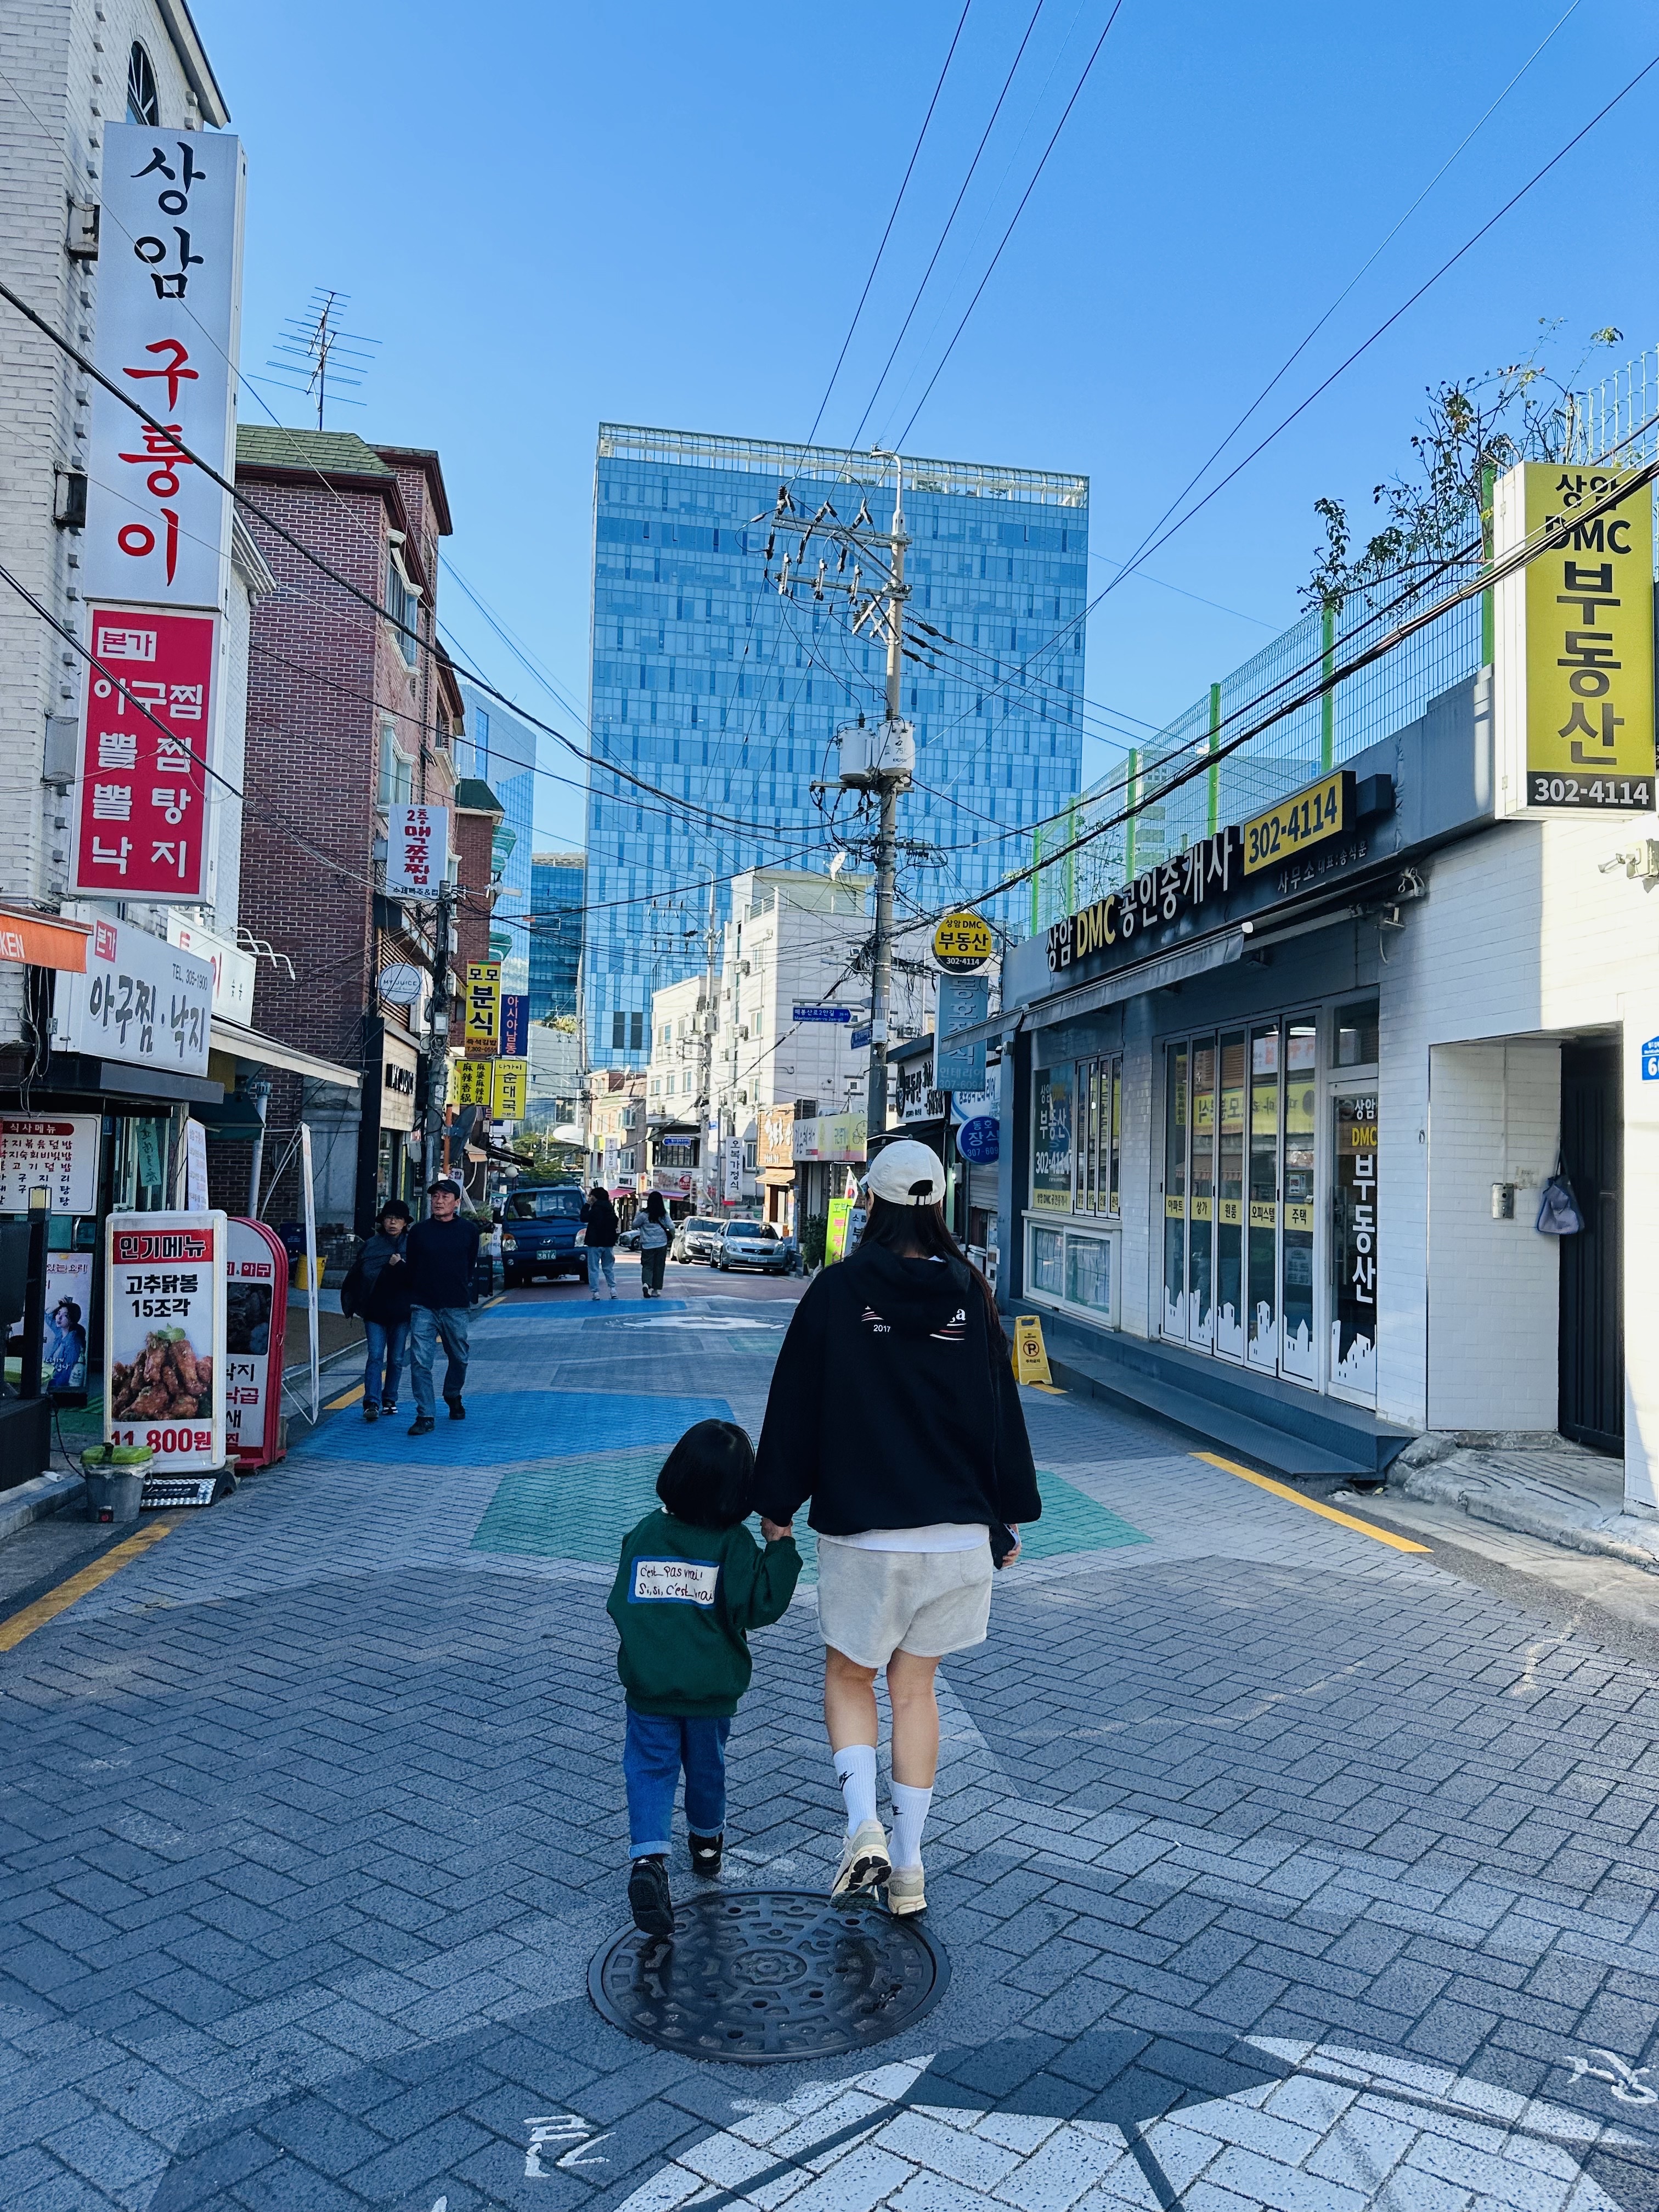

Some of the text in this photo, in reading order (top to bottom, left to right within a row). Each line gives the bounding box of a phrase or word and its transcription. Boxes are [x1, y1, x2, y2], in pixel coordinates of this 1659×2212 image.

[131, 142, 205, 300] 상암
[1555, 473, 1620, 511] 상암
[1544, 515, 1632, 555] DMC
[102, 632, 152, 656] 본가
[1556, 561, 1625, 766] 부동산
[94, 678, 204, 720] 아구찜
[1534, 778, 1649, 805] 302-4114
[407, 809, 429, 825] 2층
[1249, 785, 1338, 865] 302-4114
[1278, 860, 1315, 894] 사무소
[1046, 834, 1233, 973] 상암 DMC 공인중개사
[946, 919, 982, 929] 상암 DMC
[97, 926, 116, 958] 본가
[939, 932, 989, 952] 부동산
[946, 957, 980, 966] 302-4114
[186, 968, 208, 991] 305-1900
[468, 968, 500, 981] 모모
[469, 985, 496, 1036] 분식
[949, 979, 979, 1066] 동호식
[939, 1066, 985, 1079] 인테리어
[905, 1070, 922, 1105] 부동산
[939, 1080, 984, 1091] 307-6094
[1354, 1098, 1376, 1120] 상암
[10, 1123, 56, 1134] 식사메뉴
[973, 1120, 992, 1130] 동호
[1351, 1126, 1378, 1147] DMC
[730, 1140, 740, 1190] 오복가정식
[1168, 1200, 1183, 1214] 아파트
[1197, 1200, 1207, 1215] 상가
[1225, 1203, 1237, 1219] 원룸
[1251, 1206, 1275, 1223] 오피스텔
[1292, 1208, 1307, 1225] 주택
[1352, 1154, 1376, 1304] 부동산
[120, 1235, 206, 1260] 인기메뉴
[126, 1274, 198, 1295] 고추닭봉
[132, 1298, 191, 1318] 15조각
[873, 1324, 891, 1333] 2017
